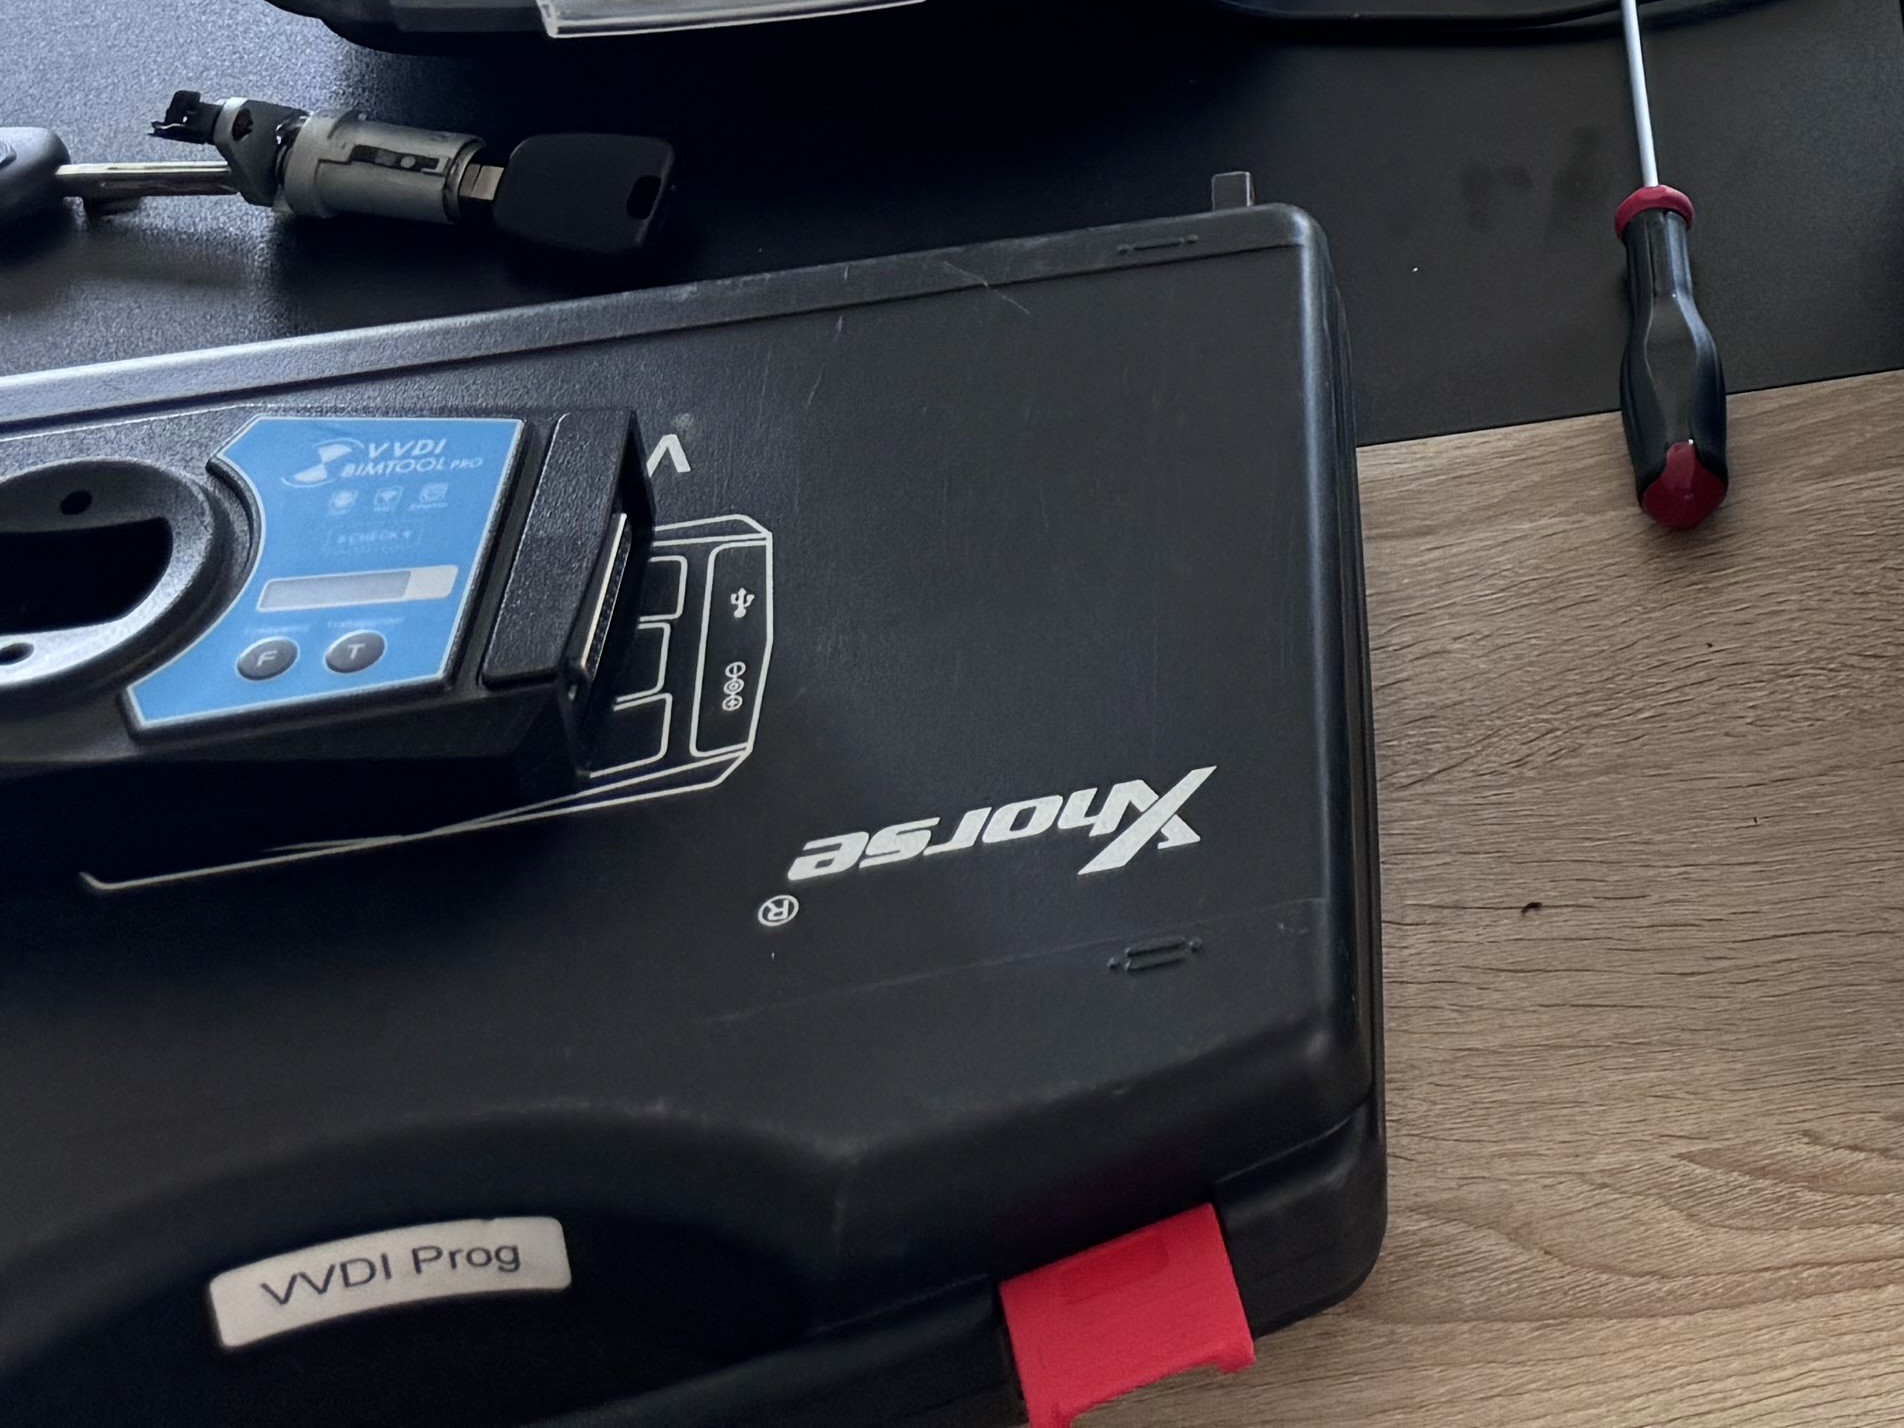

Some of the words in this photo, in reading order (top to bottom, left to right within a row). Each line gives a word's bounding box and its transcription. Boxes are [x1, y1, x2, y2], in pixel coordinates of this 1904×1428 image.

[368, 438, 448, 459] VVDI
[340, 457, 449, 479] BIMTOOL
[450, 457, 484, 471] PRO
[256, 649, 278, 668] F
[347, 643, 366, 660] T
[787, 765, 1217, 881] Xhorse
[260, 1252, 391, 1306] VVDI
[411, 1244, 522, 1275] Prog
